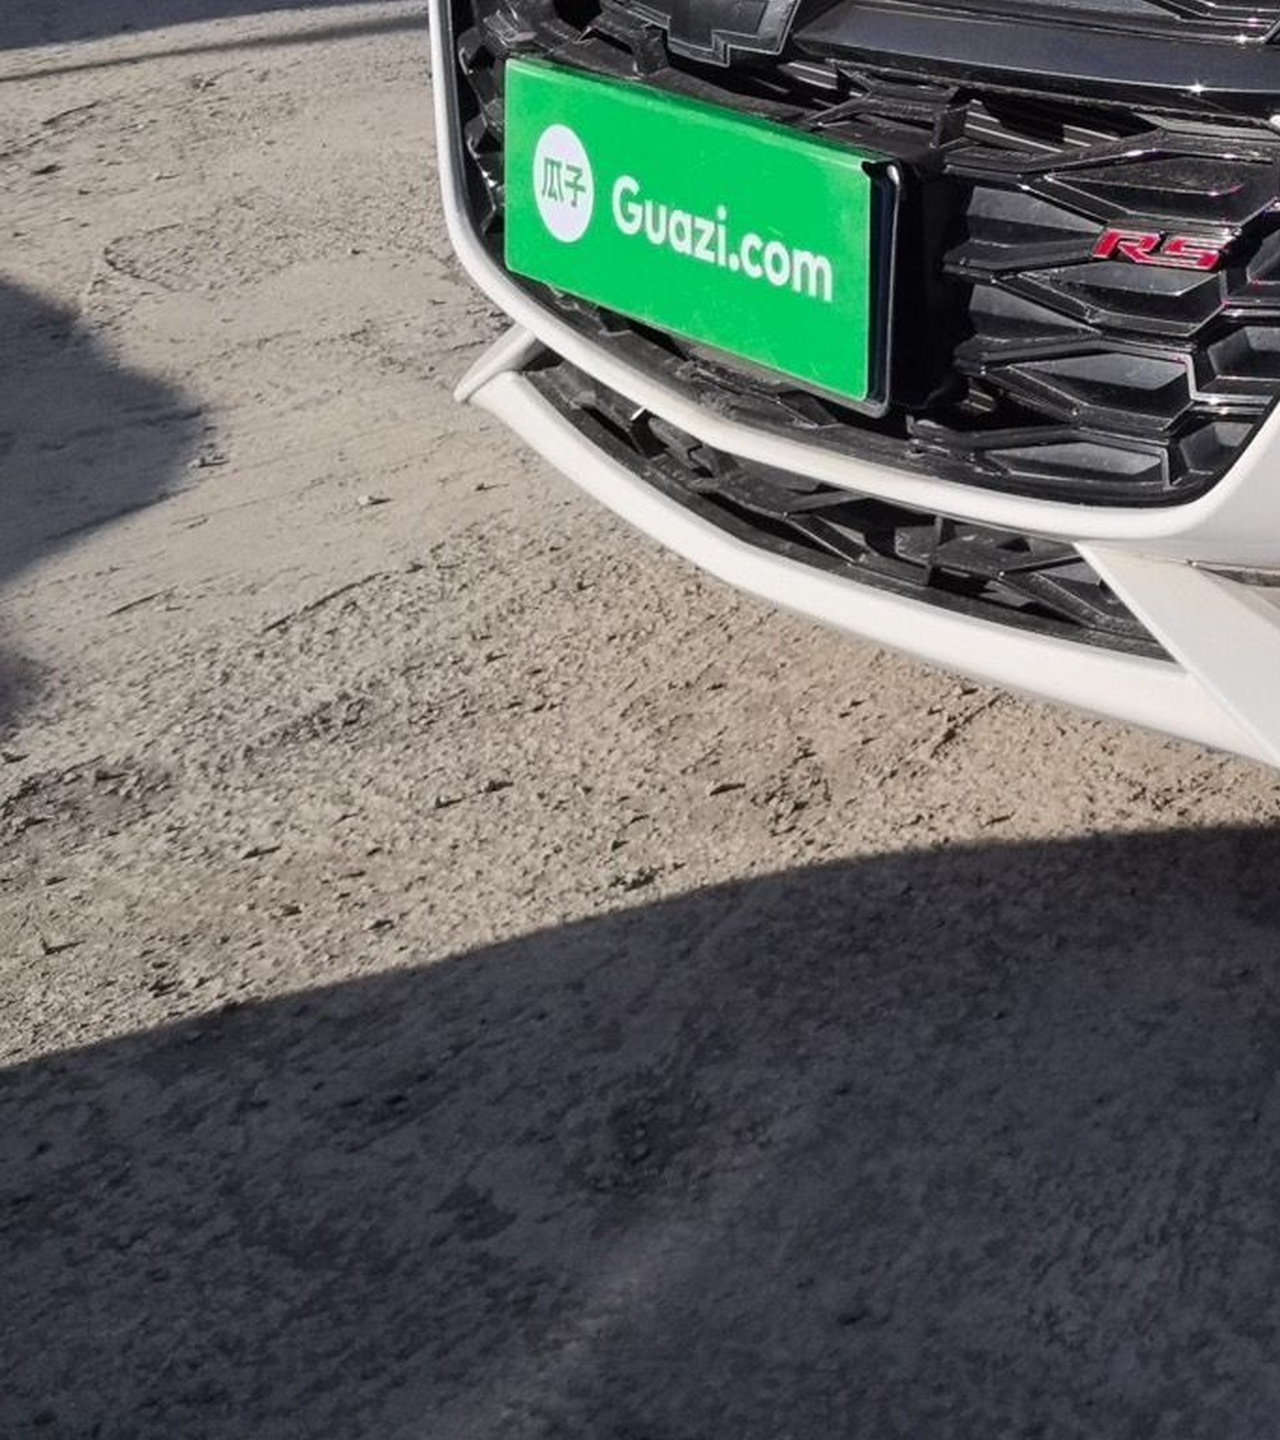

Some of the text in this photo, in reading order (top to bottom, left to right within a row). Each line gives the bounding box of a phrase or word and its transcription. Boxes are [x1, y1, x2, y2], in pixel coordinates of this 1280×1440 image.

[541, 157, 586, 208] 瓜子
[612, 175, 833, 303] Guazi.com
[1092, 227, 1226, 271] RS
